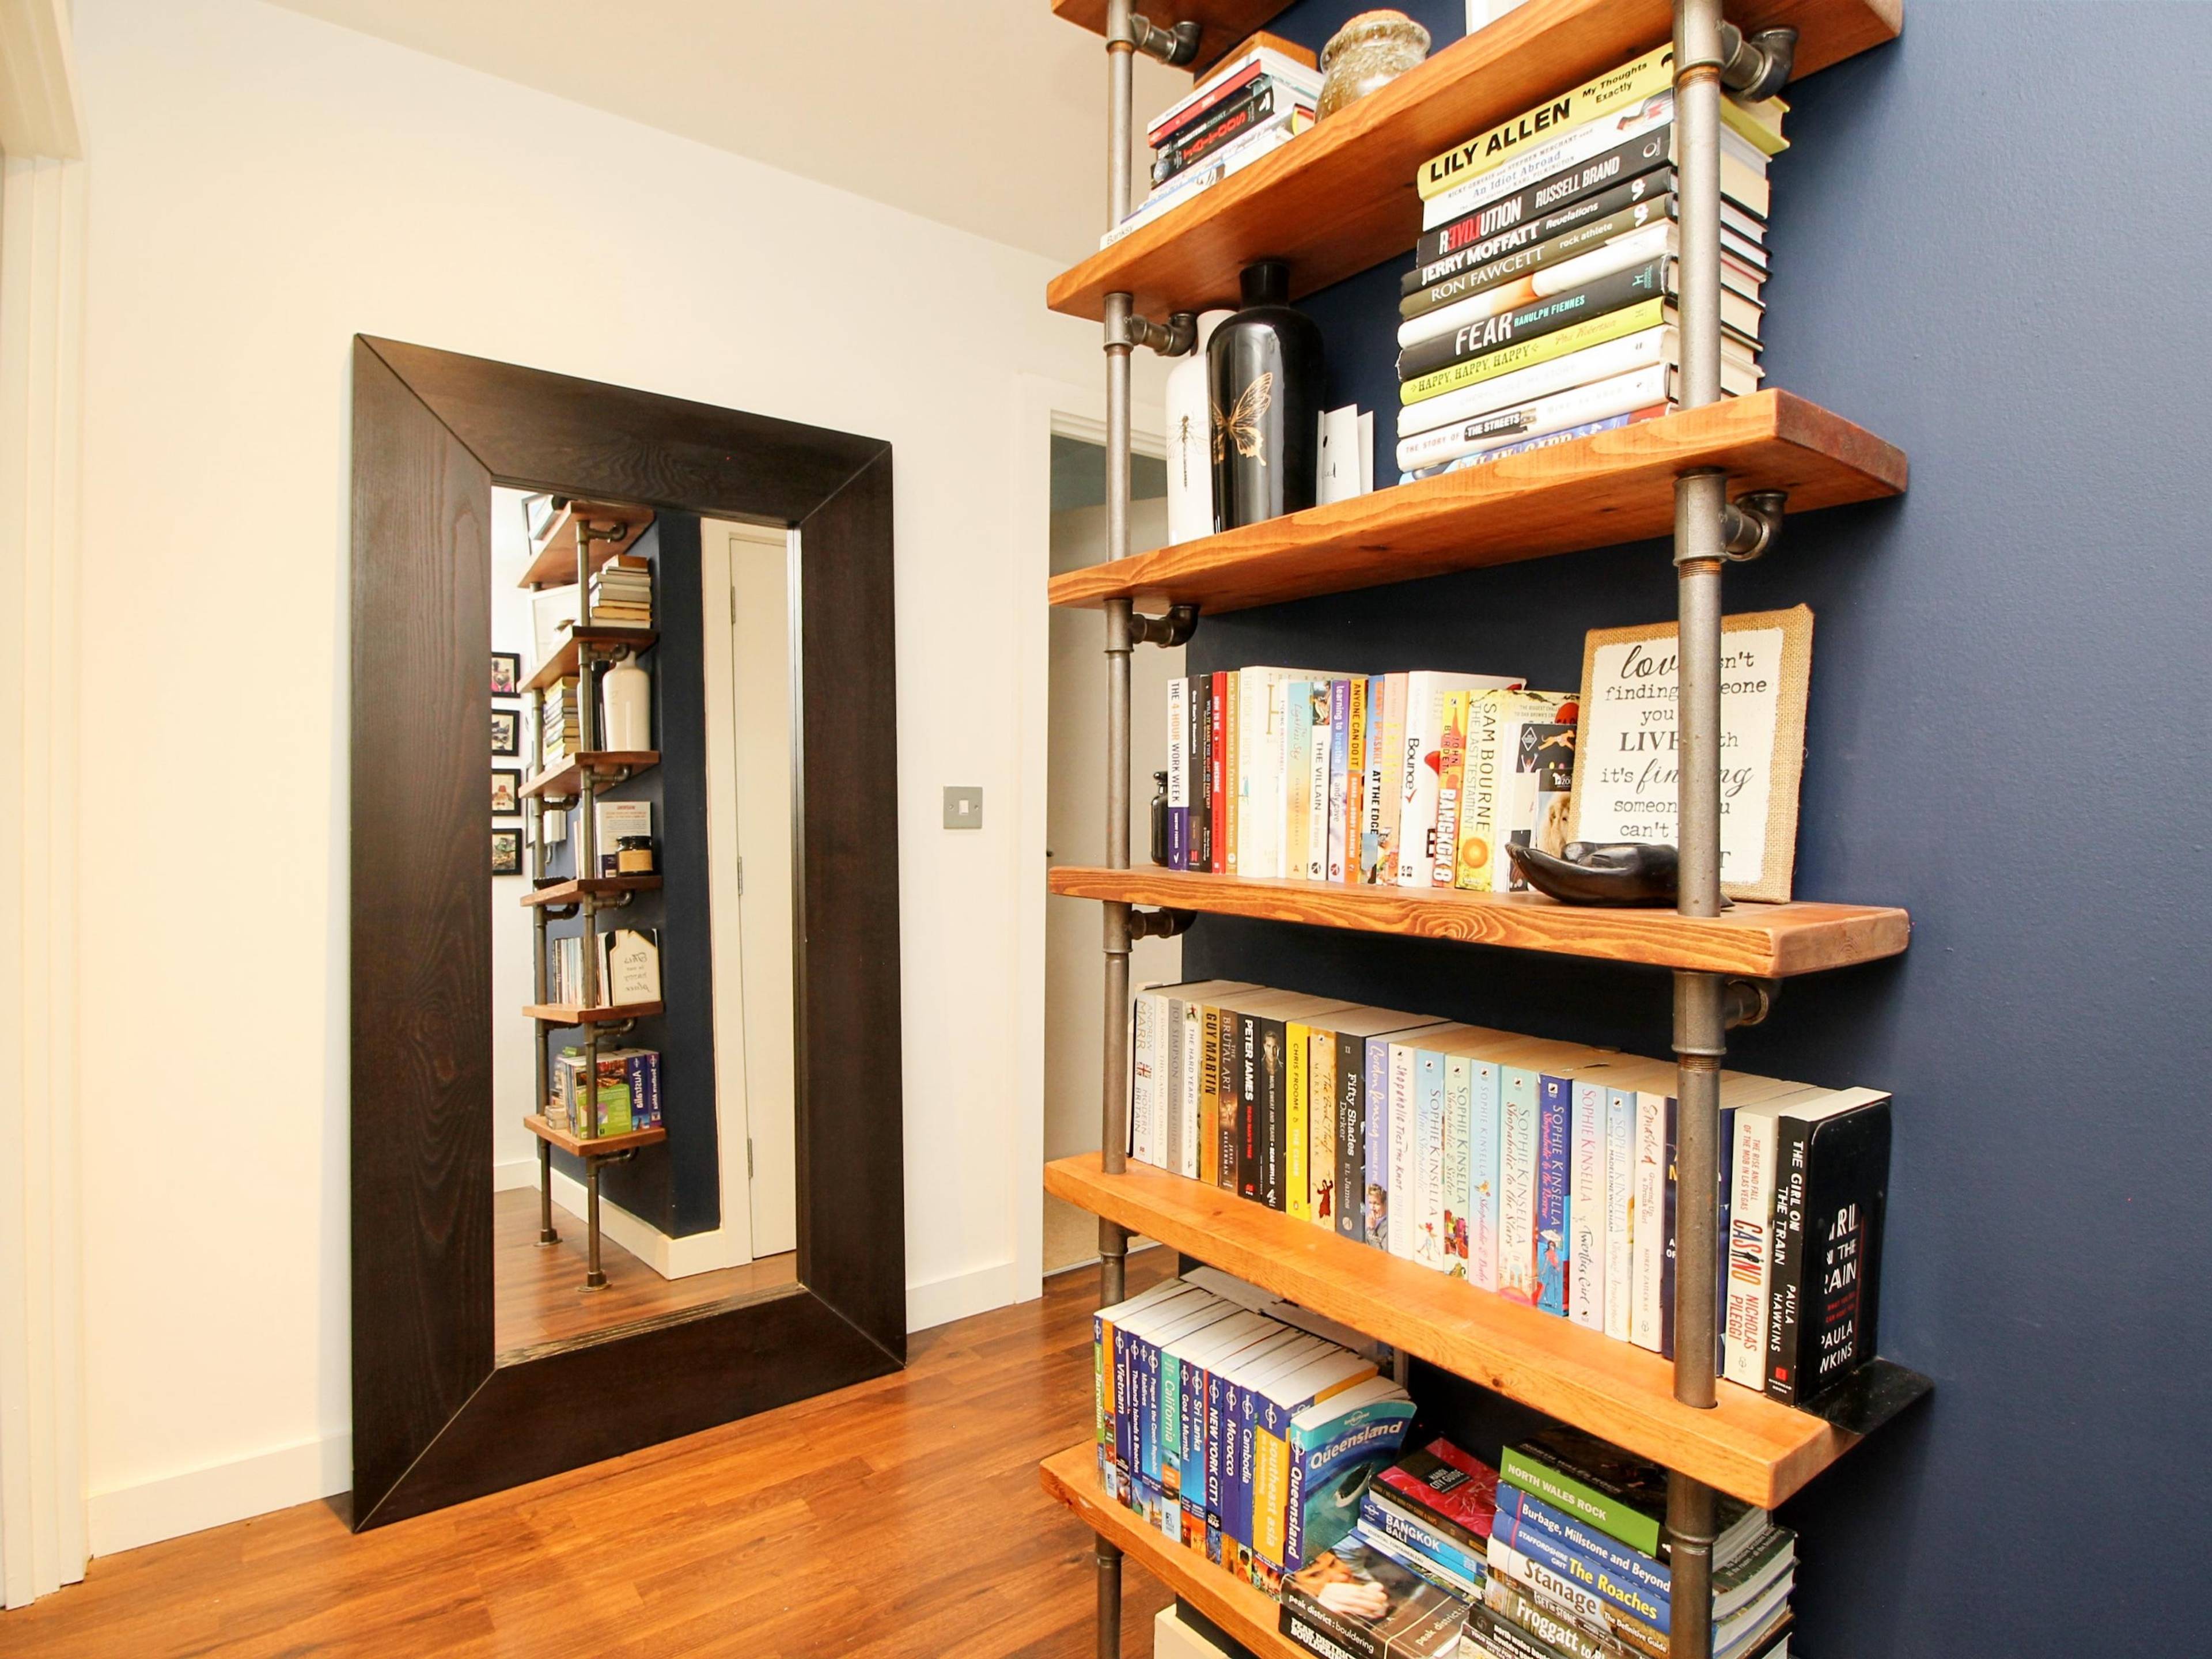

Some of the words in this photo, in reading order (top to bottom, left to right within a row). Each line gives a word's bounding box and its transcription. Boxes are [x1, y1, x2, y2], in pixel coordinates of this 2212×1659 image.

[1582, 85, 1597, 99] My
[1600, 61, 1647, 91] Thoughts
[1596, 80, 1633, 104] Exactly
[1430, 143, 1479, 183] LILY
[1486, 97, 1571, 160] ALLEN
[1473, 185, 1487, 196] An
[1490, 171, 1518, 190] Idiot
[1521, 151, 1562, 179] Abroad
[1535, 175, 1581, 209] RUSSELL
[1581, 156, 1620, 190] BRAND
[1107, 225, 1134, 245] Banksy
[1421, 250, 1464, 286] JERRY
[1465, 222, 1540, 266] MOFFATT
[1546, 202, 1599, 231] Revelations
[1430, 279, 1465, 302] RON
[1469, 245, 1546, 286] FAWCETT
[1559, 233, 1580, 250] rock
[1581, 222, 1613, 243] athlete
[1455, 312, 1513, 356] FEAR
[1514, 307, 1550, 328] RANULPH
[1551, 294, 1585, 316] FIENNES
[1418, 369, 1452, 392] HAPPY,
[1455, 357, 1491, 381] HAPPY,
[1494, 344, 1531, 369] HAPPY
[1406, 442, 1420, 453] THE
[1423, 436, 1446, 449] STORY
[1451, 431, 1461, 442] OF
[1467, 421, 1483, 437] THE
[1483, 413, 1522, 432] STREETS
[1620, 645, 1679, 679] lov
[1171, 683, 1180, 700] THE
[1334, 685, 1345, 721] learning
[1352, 683, 1361, 719] ANYONE
[1605, 684, 1679, 702] finding
[1171, 704, 1180, 741] 4-HOUR
[1335, 722, 1344, 730] to
[1351, 722, 1360, 740] CAN
[1470, 704, 1481, 726] THE
[1483, 703, 1498, 741] SAM
[1641, 709, 1674, 726] you
[1171, 743, 1180, 772] WORK
[1334, 732, 1343, 763] breathe
[1350, 757, 1359, 766] IT
[1351, 743, 1359, 755] DO
[1442, 725, 1451, 774] BURDETT
[1451, 738, 1460, 764] JOHN
[1469, 731, 1480, 758] LAST
[1373, 770, 1381, 783] AT
[1406, 738, 1420, 789] Bounce
[1601, 768, 1634, 783] it's
[1636, 758, 1754, 797] finng
[1171, 775, 1180, 802] WEEK
[1314, 767, 1323, 810] VILLAIN
[1372, 786, 1381, 805] THE
[1463, 764, 1478, 831] TESTAMENT
[1476, 749, 1494, 832] BOURNE
[1613, 798, 1678, 813] someon
[1370, 808, 1380, 835] EDGE
[1620, 822, 1670, 839] can't
[1433, 868, 1453, 882] 8
[1206, 1013, 1217, 1039] GUY
[1222, 1016, 1232, 1064] BRUTAL
[1245, 1019, 1253, 1059] PETER
[1205, 1040, 1217, 1096] MARTIN
[1222, 1066, 1231, 1092] ART
[1245, 1060, 1253, 1101] JAMES
[1368, 1045, 1385, 1089] Gordon
[1346, 1073, 1357, 1106] Fifty
[1339, 1101, 1347, 1141] Darker
[1366, 1092, 1385, 1138] Ramsay
[1581, 1088, 1597, 1134] SOPHIE
[1744, 1124, 1751, 1133] OF
[1347, 1109, 1357, 1156] Shades
[1580, 1139, 1596, 1202] KINSELLA
[1742, 1166, 1750, 1175] IN
[1743, 1149, 1751, 1164] MOB
[1792, 1141, 1804, 1167] THE
[1740, 1189, 1749, 1210] VEGAS
[1741, 1176, 1749, 1188] LAS
[1776, 1187, 1789, 1214] THE
[1790, 1173, 1802, 1207] GIRL
[1789, 1210, 1801, 1232] ON
[1578, 1225, 1594, 1272] Twenties
[1772, 1221, 1787, 1265] TRAIN
[1578, 1277, 1592, 1304] Girl
[1785, 1283, 1797, 1324] PAULA
[1728, 1294, 1744, 1340] PILEGGI
[1743, 1294, 1760, 1352] NICHOLAS
[1770, 1293, 1783, 1353] HAWKINS
[1095, 1373, 1104, 1429] Barcelona
[1116, 1363, 1126, 1414] Vietnam
[1132, 1370, 1140, 1406] Thailand's
[1164, 1380, 1176, 1443] California
[1193, 1399, 1202, 1416] Sri
[1209, 1407, 1218, 1437] NEW
[1181, 1423, 1190, 1461] Mumbai
[1193, 1418, 1202, 1451] Lanka
[1226, 1419, 1236, 1476] Morocco
[1310, 1421, 1403, 1470] Queensland
[1209, 1440, 1218, 1474] YORK
[1242, 1428, 1252, 1484] Cambodia
[1209, 1476, 1218, 1507] CITY
[1268, 1440, 1280, 1513] southeast
[1508, 1463, 1540, 1487] NORTH
[1541, 1479, 1575, 1504] WALES
[1577, 1496, 1607, 1521] ROCK
[1267, 1516, 1278, 1547] asia
[1287, 1467, 1303, 1559] Queensland
[1385, 1513, 1441, 1552] BANGKOK
[1385, 1525, 1408, 1543] BALI
[1517, 1529, 1569, 1562] STAFFORDSHIRE
[1522, 1503, 1562, 1535] Burbage,
[1565, 1521, 1608, 1559] Millstone
[1610, 1550, 1631, 1571] and
[1631, 1562, 1671, 1594] Beyond
[1551, 1556, 1567, 1570] GRIT
[1524, 1558, 1597, 1615] Stanage
[1569, 1557, 1594, 1585] The
[1597, 1571, 1658, 1620] Roaches
[1516, 1596, 1580, 1653] Froggatt
[1603, 1611, 1616, 1626] The
[1616, 1618, 1647, 1642] Definitive
[1647, 1635, 1668, 1653] Guide
